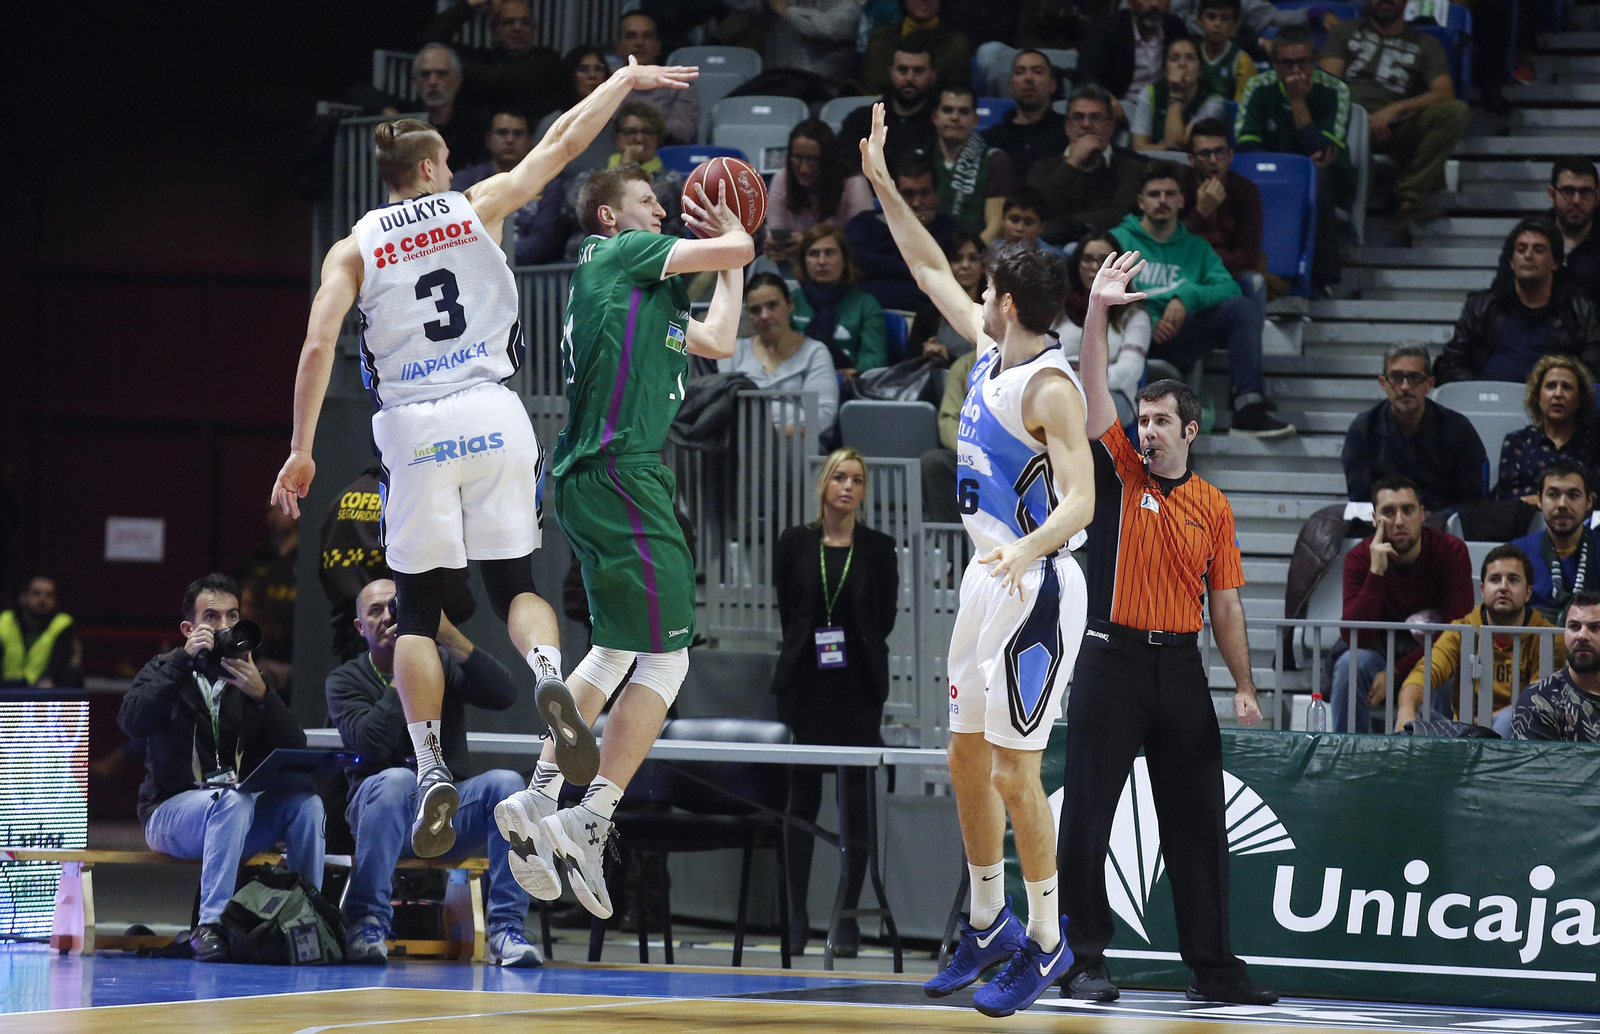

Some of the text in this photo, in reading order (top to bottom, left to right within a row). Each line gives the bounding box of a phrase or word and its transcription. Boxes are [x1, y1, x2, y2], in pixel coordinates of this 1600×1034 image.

[379, 198, 451, 232] DULKYS
[400, 220, 473, 253] cenor
[1138, 262, 1181, 287] NIKE
[414, 267, 468, 343] 3
[1272, 859, 1600, 964] Unicaja
